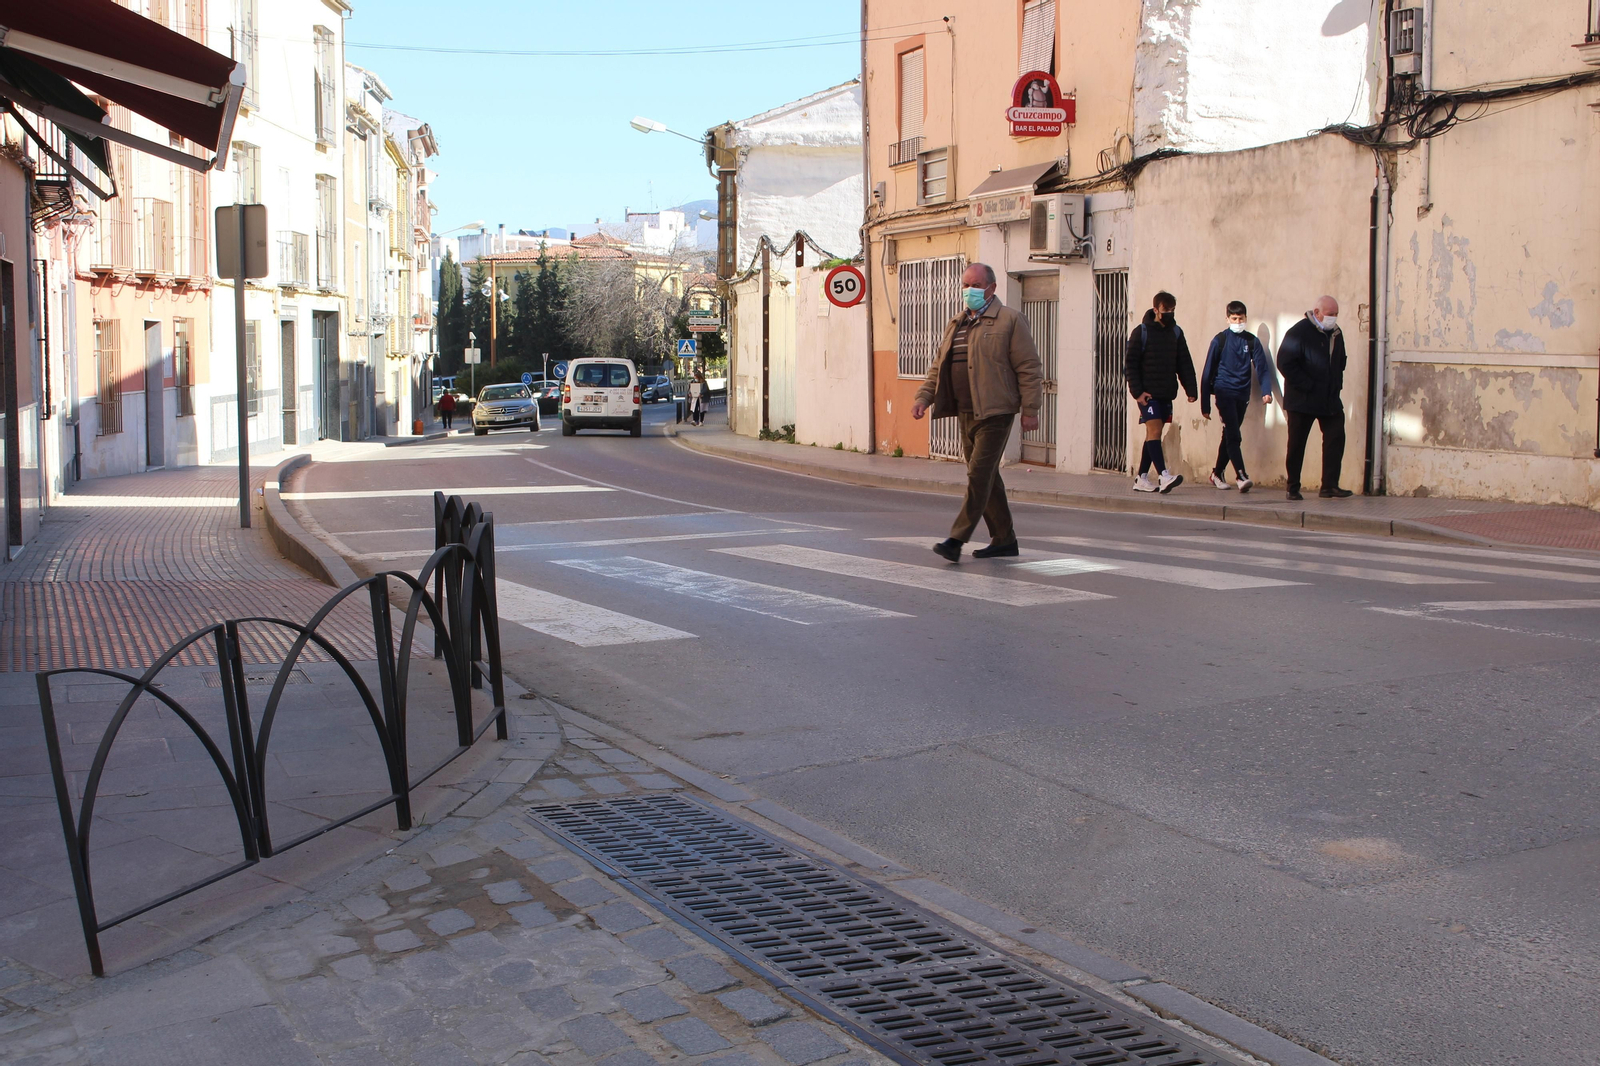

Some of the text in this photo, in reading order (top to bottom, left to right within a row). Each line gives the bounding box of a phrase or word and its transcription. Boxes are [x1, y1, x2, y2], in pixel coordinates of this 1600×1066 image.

[1013, 110, 1062, 121] Cruzcampo
[1107, 239, 1111, 251] 8
[833, 278, 857, 295] 50
[1147, 406, 1154, 415] 4
